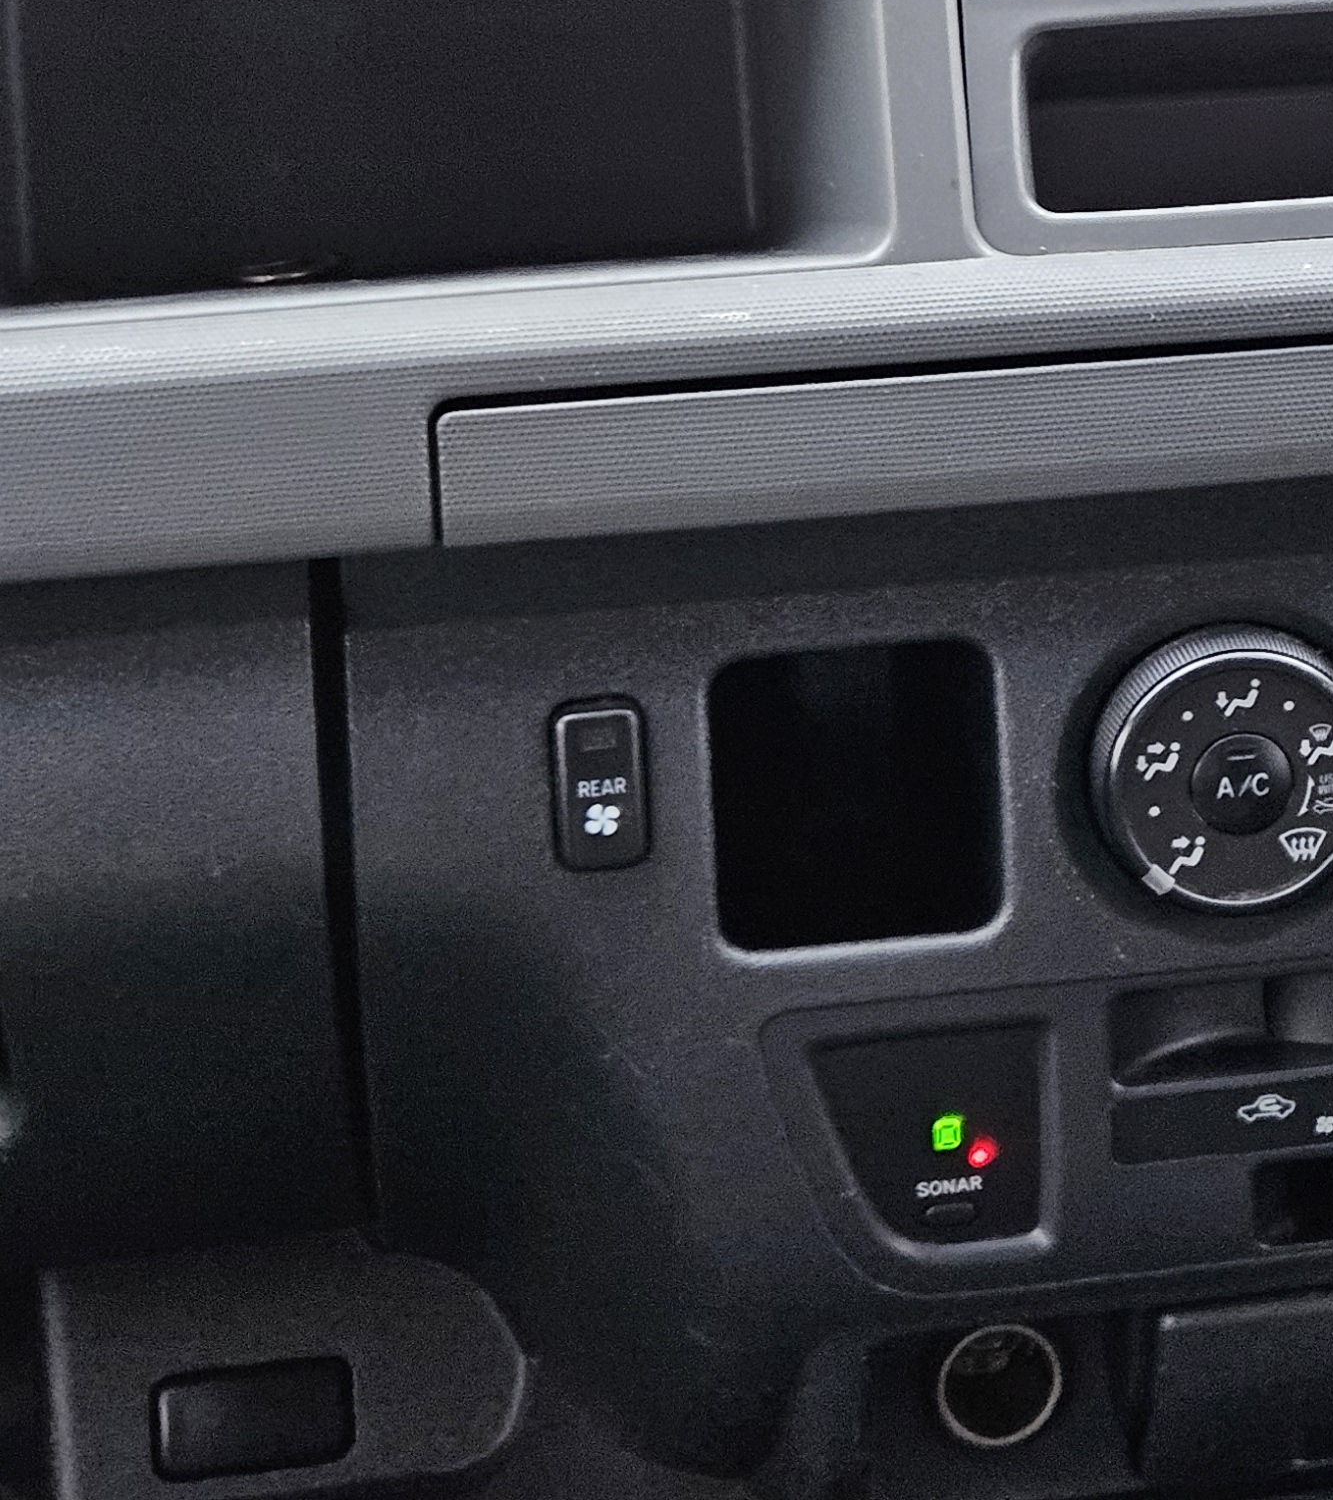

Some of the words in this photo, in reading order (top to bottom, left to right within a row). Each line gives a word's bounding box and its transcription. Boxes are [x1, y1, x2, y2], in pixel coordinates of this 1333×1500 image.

[577, 777, 628, 799] REAR
[1216, 772, 1271, 800] A/C
[916, 1175, 983, 1198] SONAR
